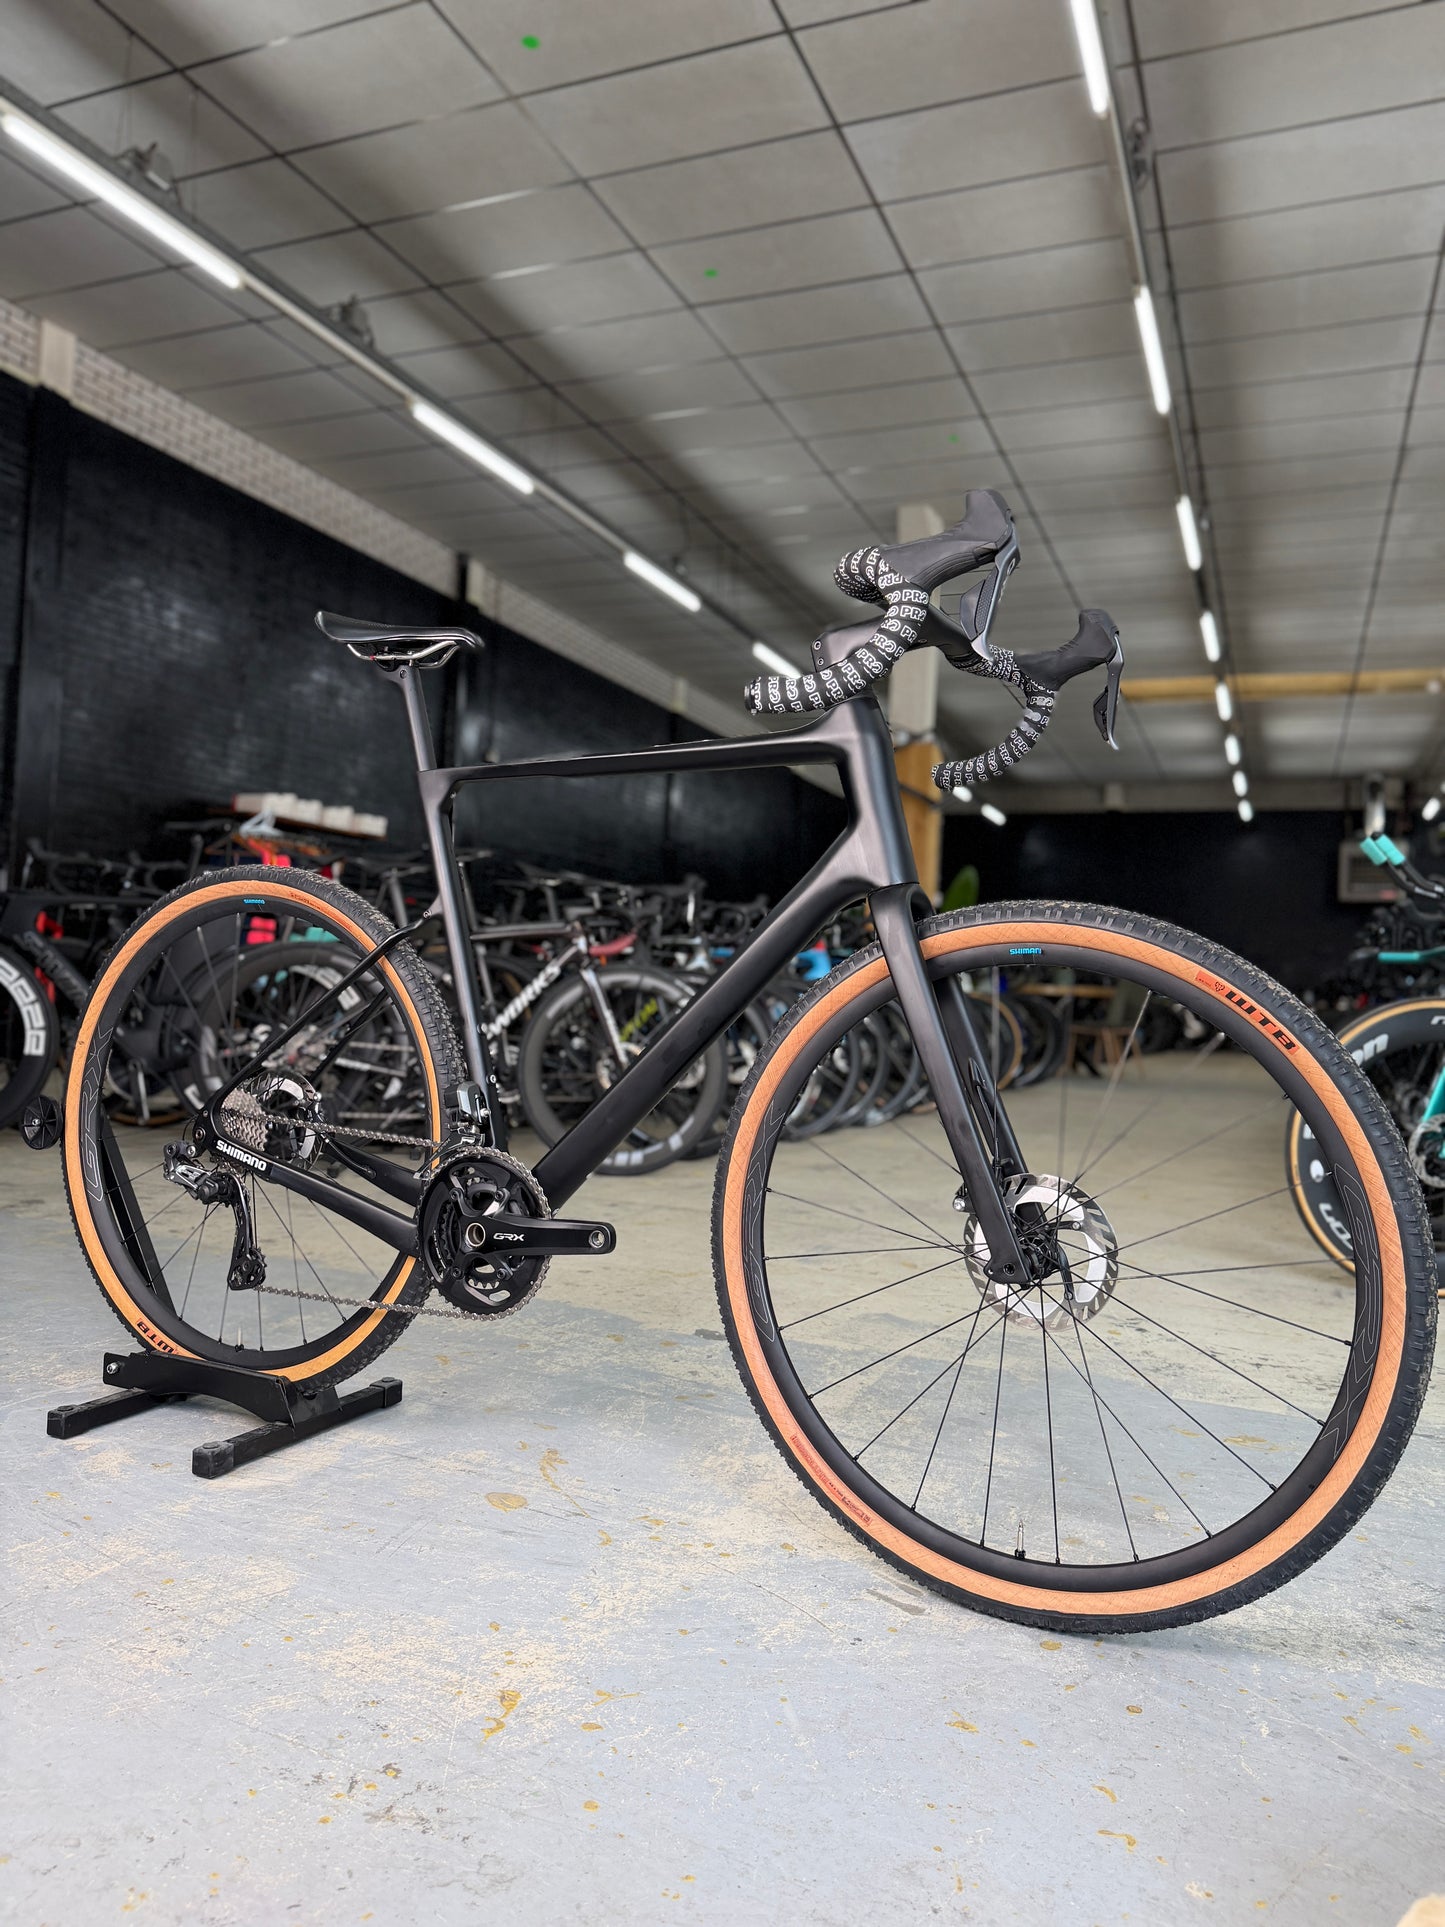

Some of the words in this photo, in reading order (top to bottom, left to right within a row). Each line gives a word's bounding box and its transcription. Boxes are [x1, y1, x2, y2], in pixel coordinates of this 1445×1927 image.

[857, 648, 883, 674] PRO
[1225, 990, 1296, 1051] WTB
[216, 1139, 267, 1172] SHIMANO
[493, 1232, 525, 1242] GRX
